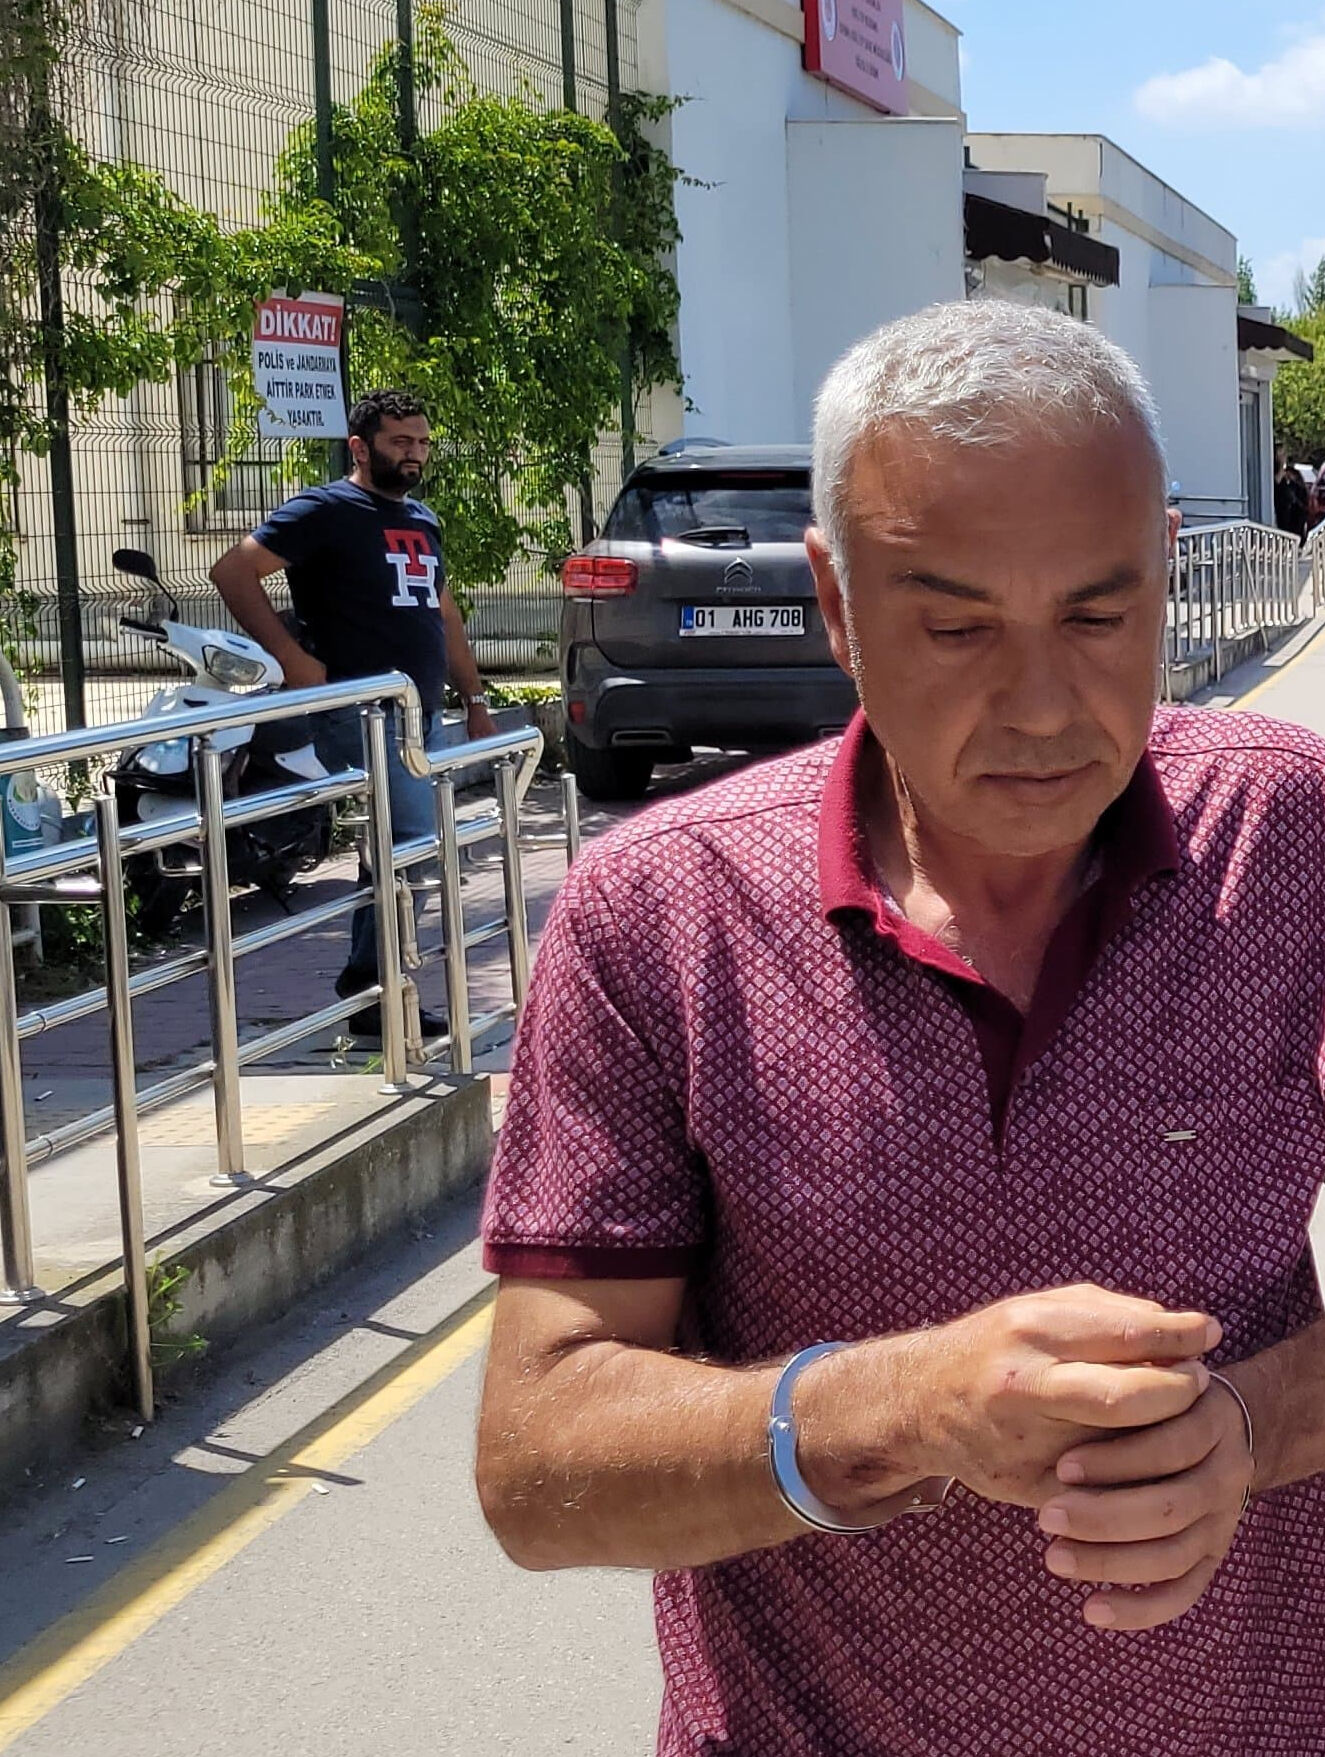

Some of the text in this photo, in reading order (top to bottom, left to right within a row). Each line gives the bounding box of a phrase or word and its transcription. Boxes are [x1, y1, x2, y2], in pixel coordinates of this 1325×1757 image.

[260, 304, 336, 342] DİKKAT!
[258, 350, 284, 369] POLİS
[286, 357, 295, 370] ve
[266, 377, 293, 399] AİTTİR
[295, 381, 314, 400] PARK
[696, 610, 715, 627] 01
[733, 610, 764, 627] AHG
[770, 610, 801, 627] 708
